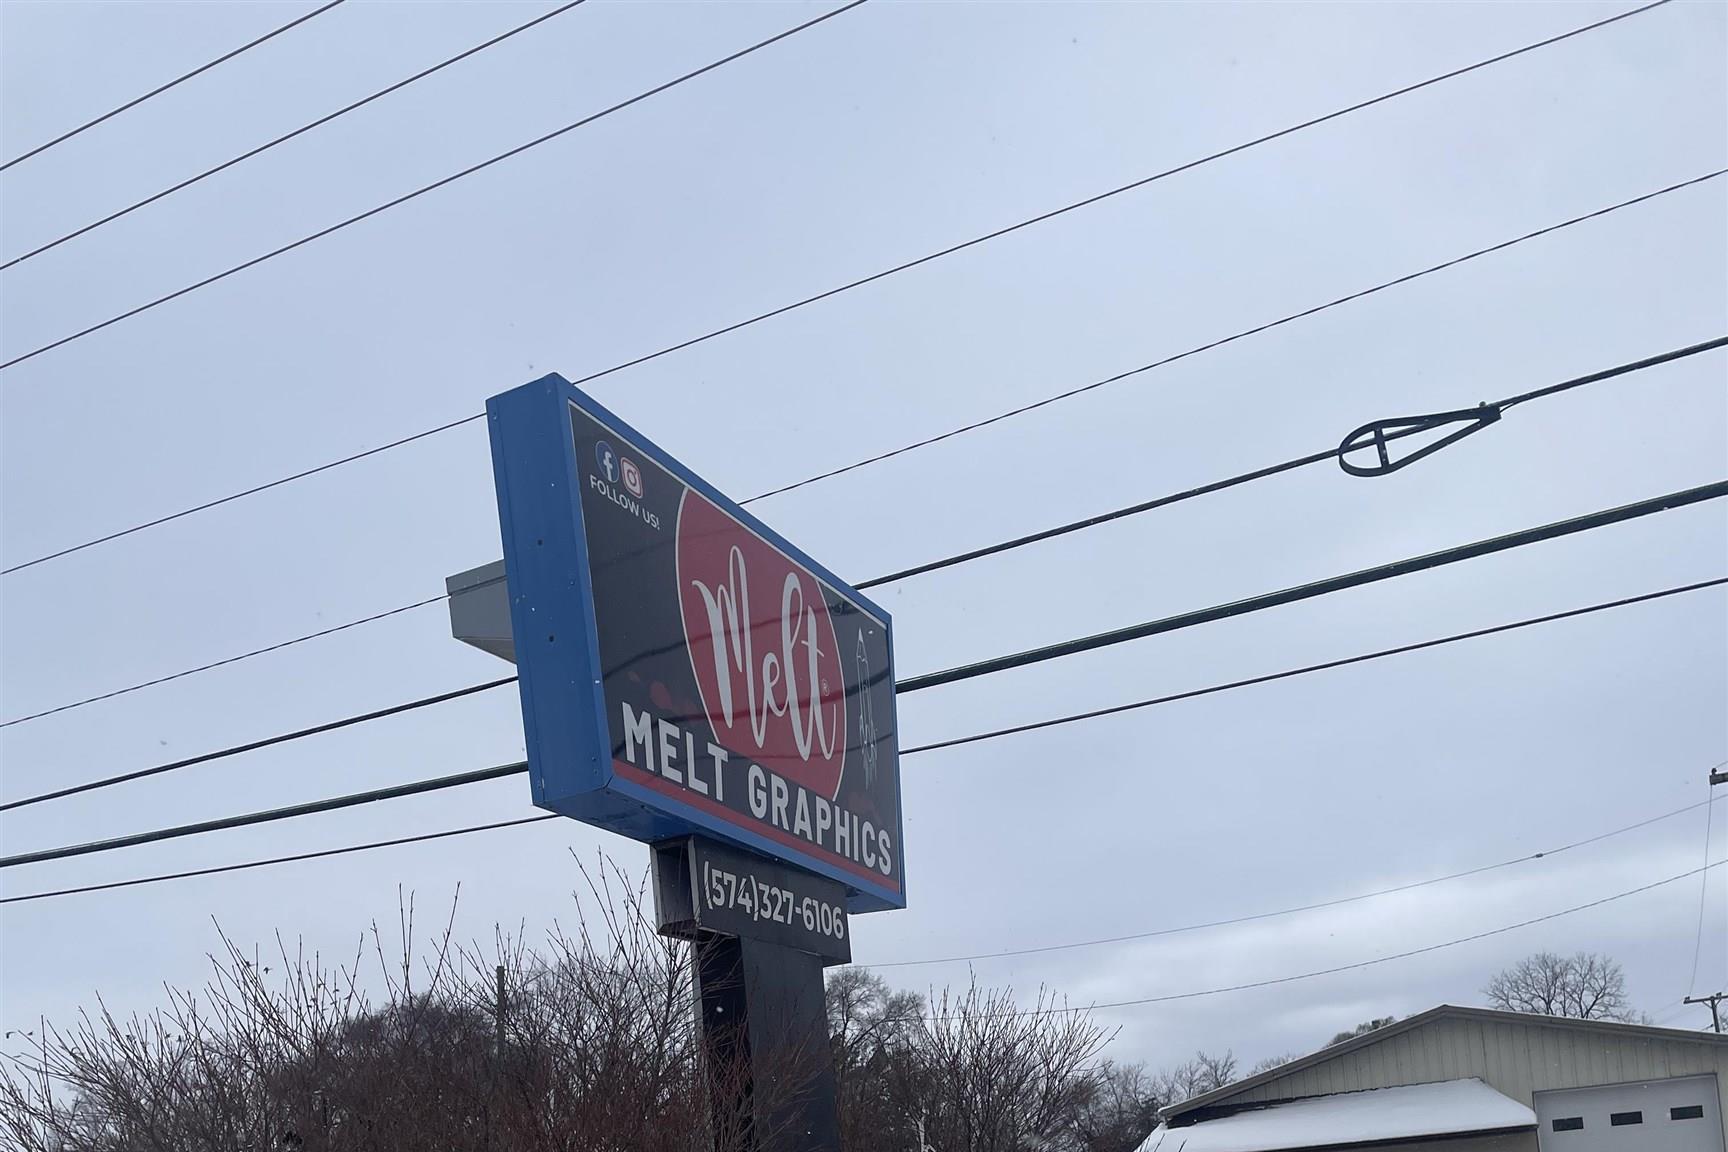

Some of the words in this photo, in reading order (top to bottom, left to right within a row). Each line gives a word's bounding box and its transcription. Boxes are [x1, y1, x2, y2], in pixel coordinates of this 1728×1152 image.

[590, 474, 640, 517] FOLLOW
[642, 508, 660, 531] US!
[692, 545, 836, 761] Melt
[622, 701, 728, 802] MELT
[748, 764, 891, 875] GRAPHICS
[704, 861, 844, 939] (574)327-6106
